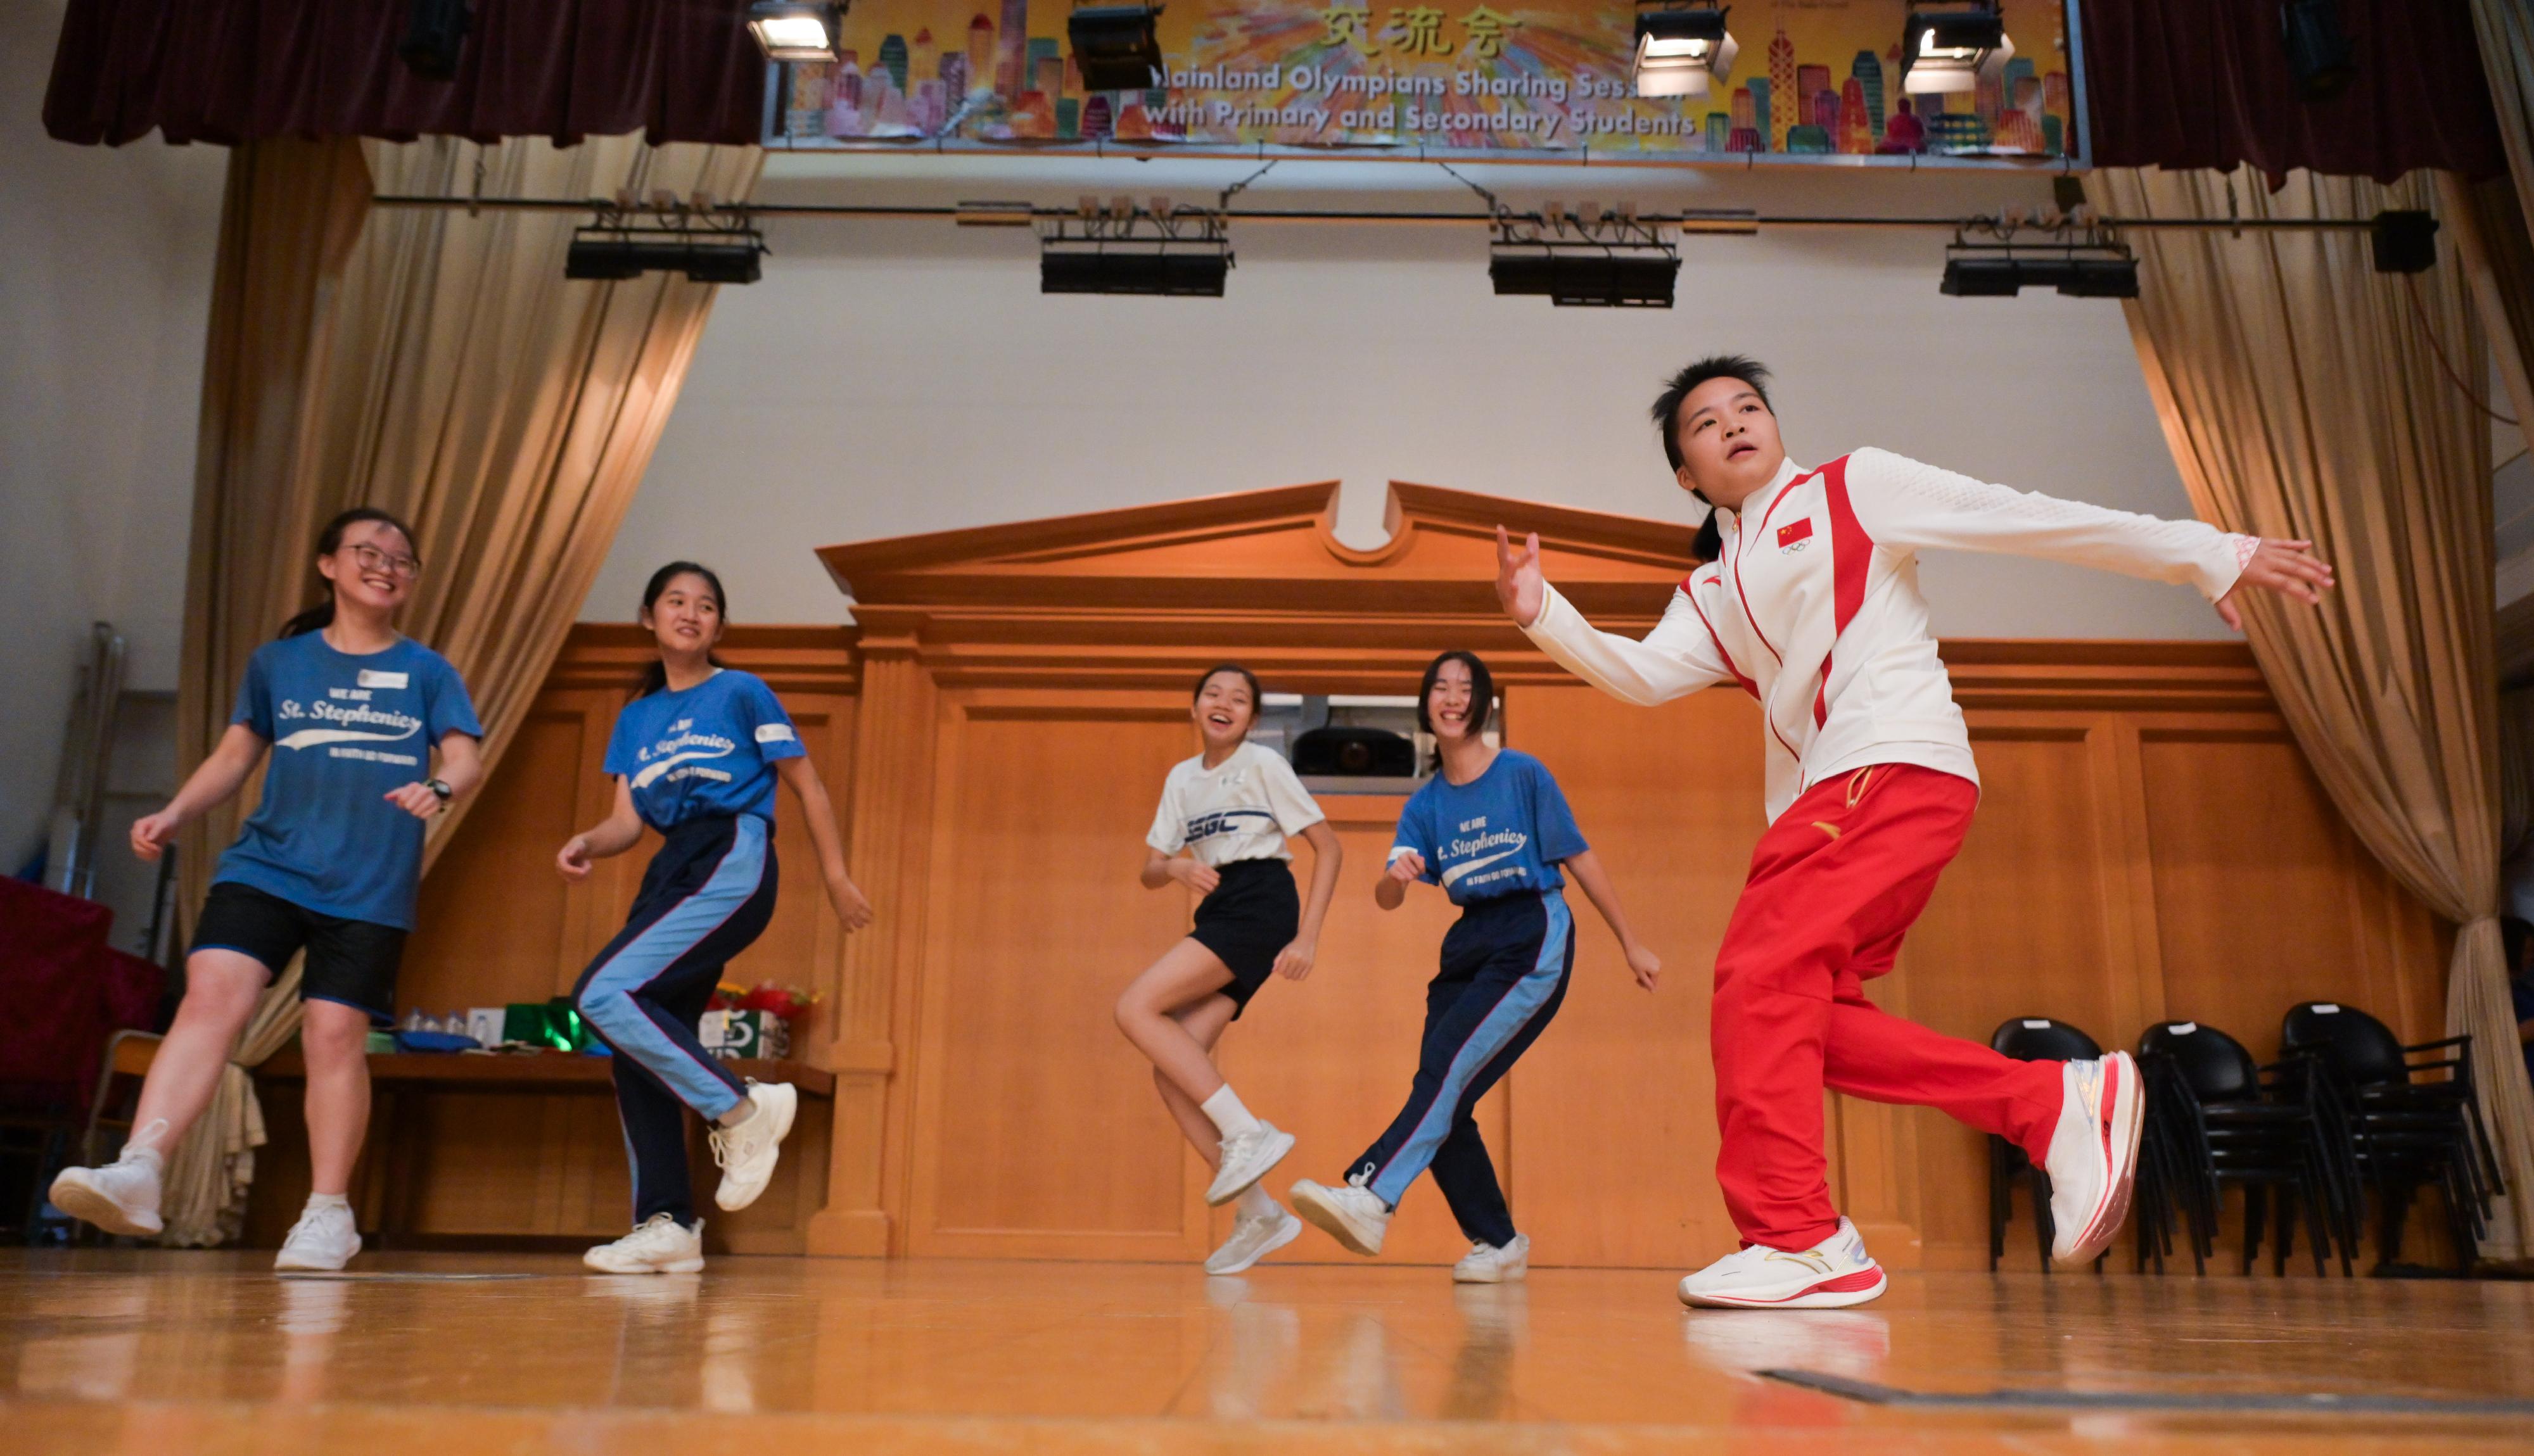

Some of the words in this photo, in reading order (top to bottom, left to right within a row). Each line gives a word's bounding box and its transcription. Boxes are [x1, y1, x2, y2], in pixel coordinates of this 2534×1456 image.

[1320, 5, 1521, 58] 交流会
[1289, 64, 1446, 99] Olympians
[1455, 68, 1568, 104] Sharing
[1576, 72, 1684, 100] Sess
[1142, 98, 1204, 125] with
[1213, 99, 1330, 132] Primary
[1340, 103, 1396, 128] and
[1404, 104, 1562, 139] Secondary
[1570, 106, 1695, 137] Students
